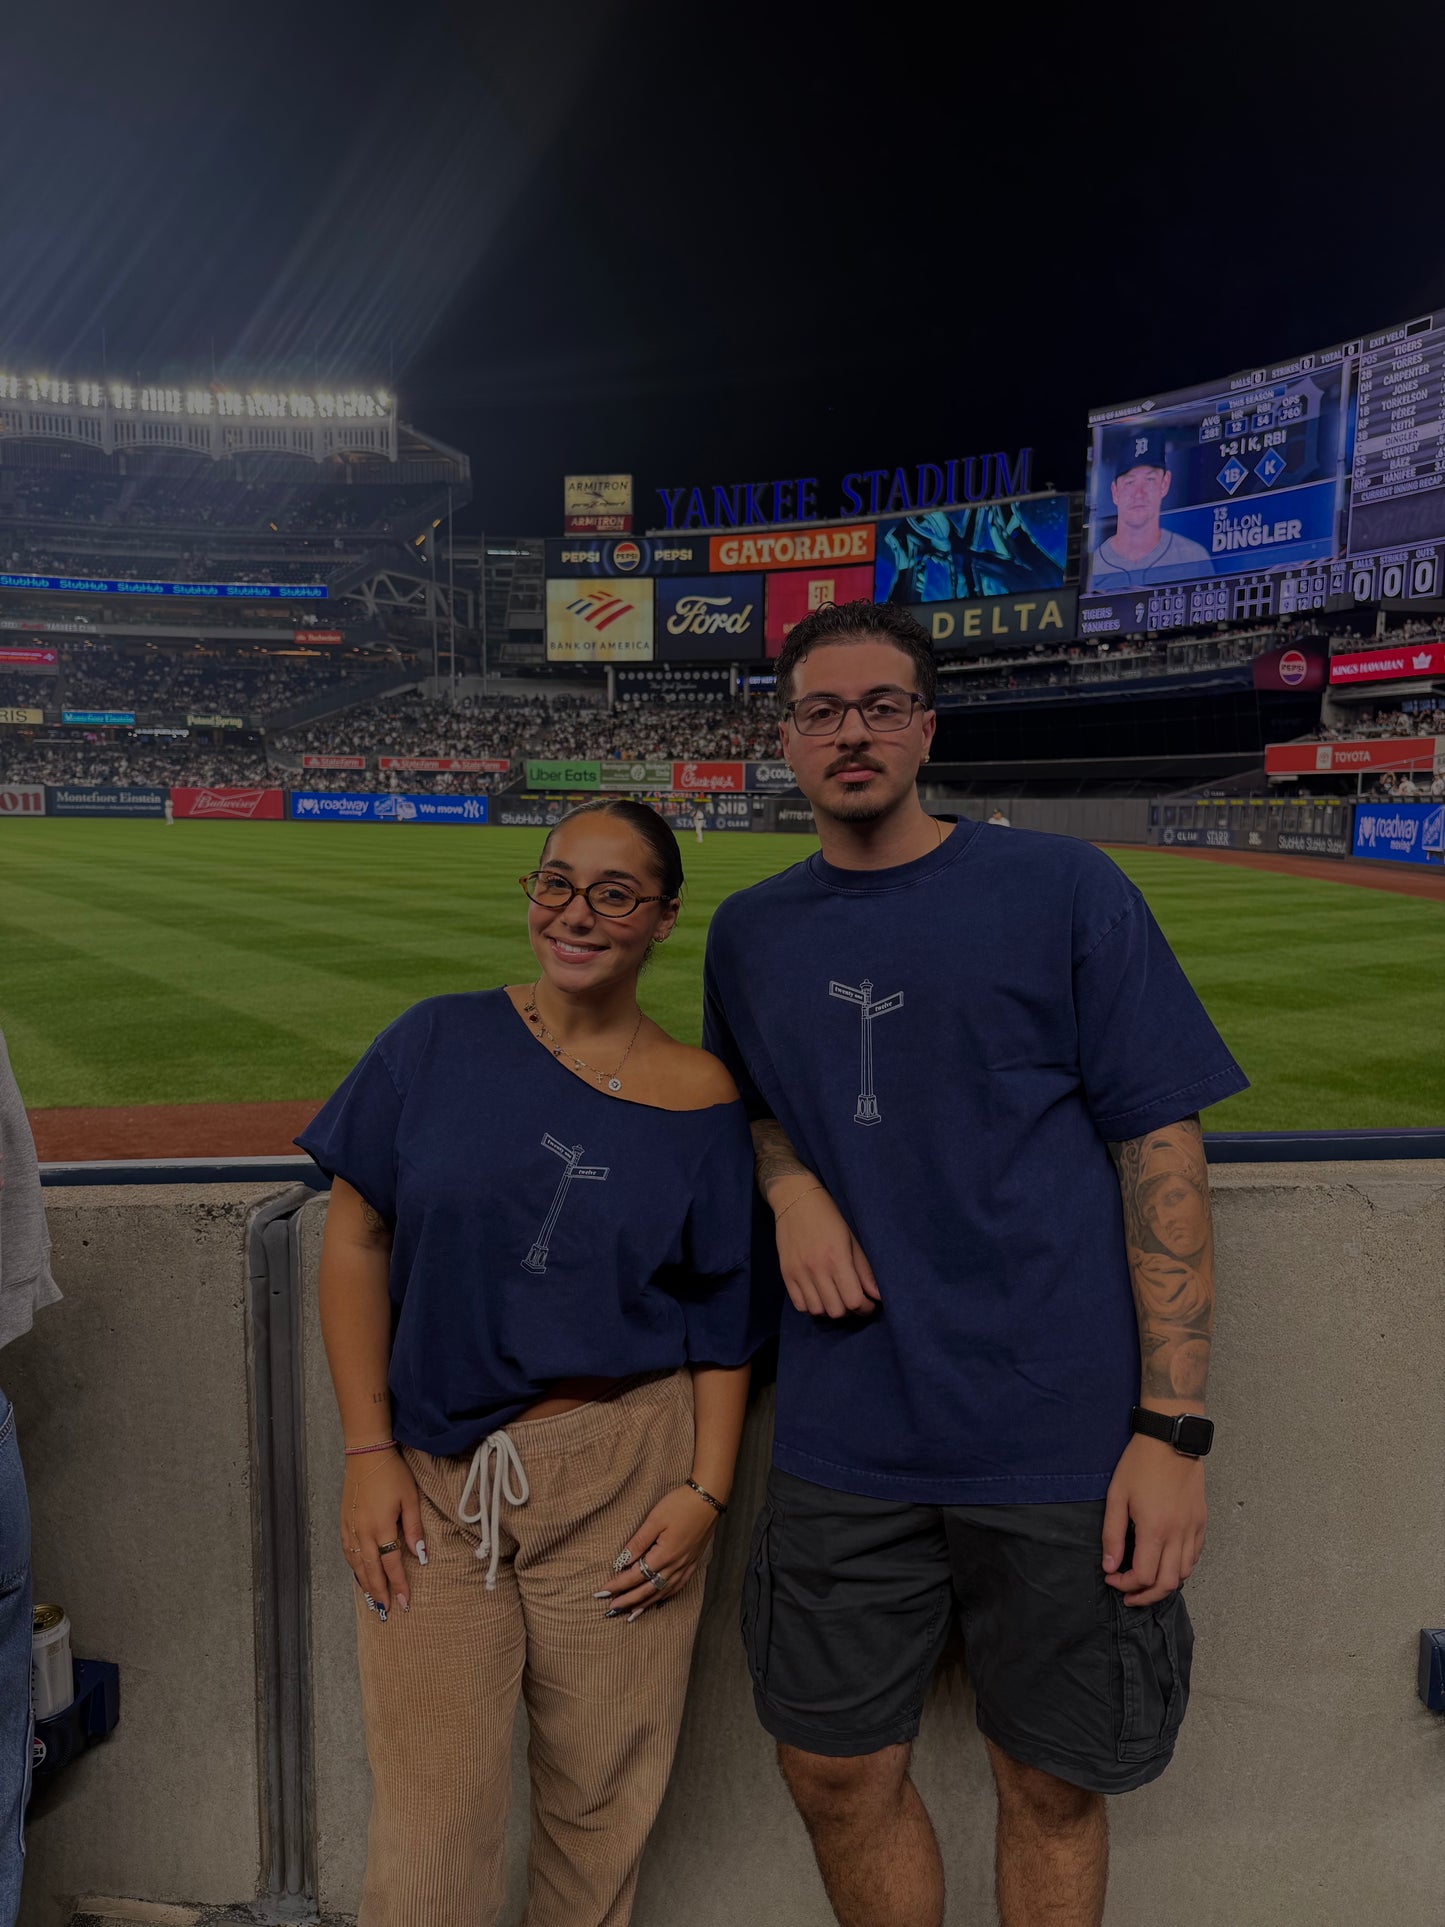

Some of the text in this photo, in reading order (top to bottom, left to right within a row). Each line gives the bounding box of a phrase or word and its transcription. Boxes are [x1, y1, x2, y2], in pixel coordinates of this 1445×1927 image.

[1394, 339, 1423, 355] TIGERS
[1321, 350, 1342, 363] TOTAL
[1392, 354, 1423, 370] TORRES
[1384, 364, 1430, 385] CARPENTER
[1392, 380, 1418, 395] JONES
[1382, 389, 1428, 410] TORKELSON
[1202, 416, 1221, 428] AVG
[1232, 422, 1242, 432] 12
[1391, 417, 1415, 432] KEITH
[1219, 442, 1238, 457] 1-2
[1264, 431, 1287, 447] RBI
[1386, 431, 1418, 445] DINGLER
[1355, 442, 1420, 466] SS SWEENEY
[1265, 459, 1276, 475] K
[1224, 468, 1240, 483] 1B
[569, 482, 628, 491] ARMITRON
[656, 447, 1032, 530] YANKEE STADIUM
[571, 516, 625, 526] ARMITRON
[1213, 513, 1262, 534] DILLON
[1212, 519, 1302, 552] DINGLER
[719, 531, 867, 565] GATORADE
[1416, 546, 1435, 559] OUTS
[561, 551, 600, 563] PEPSI
[654, 549, 693, 561] PEPSI
[1, 576, 322, 597] StubHub StubHub StubHub StubHub StubHub StubHub
[1354, 561, 1433, 601] 0 0 0
[815, 586, 828, 604] T
[667, 595, 753, 635] Ford
[932, 601, 1064, 639] DELTA
[1082, 607, 1113, 620] TIGERS
[1136, 609, 1144, 623] 7
[1082, 620, 1120, 633] YANKEES
[550, 641, 650, 650] BANK OF AMERICA
[1335, 750, 1371, 763] TOYOTA
[530, 769, 561, 780] Uber
[565, 769, 597, 782] Eats
[57, 791, 161, 803] Montefiore Einstein
[198, 796, 256, 809] Budweiser
[320, 798, 369, 813] roadway
[420, 804, 436, 813] We
[437, 806, 463, 814] move
[501, 813, 542, 825] StubHub
[1376, 814, 1419, 846] roadway
[1206, 831, 1229, 846] STARR
[835, 986, 854, 998] twenty
[875, 1001, 892, 1012] twelve
